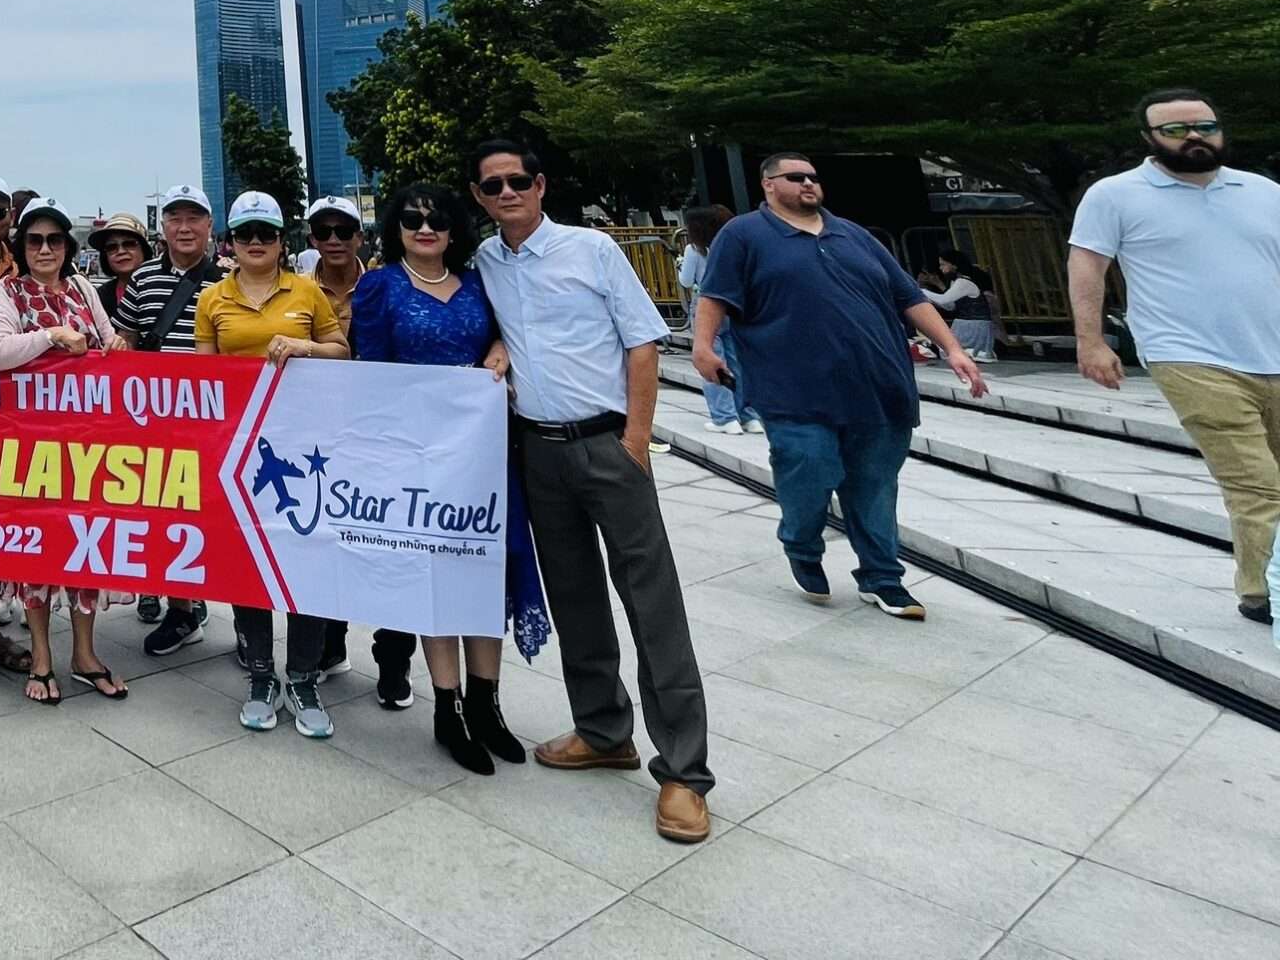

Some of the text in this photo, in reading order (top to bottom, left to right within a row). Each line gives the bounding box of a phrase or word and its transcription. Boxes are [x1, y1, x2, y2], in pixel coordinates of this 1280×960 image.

[11, 373, 112, 415] THAM
[123, 376, 225, 426] QUAN
[324, 479, 396, 523] Star
[402, 487, 501, 535] Travel
[64, 514, 206, 585] XE 2
